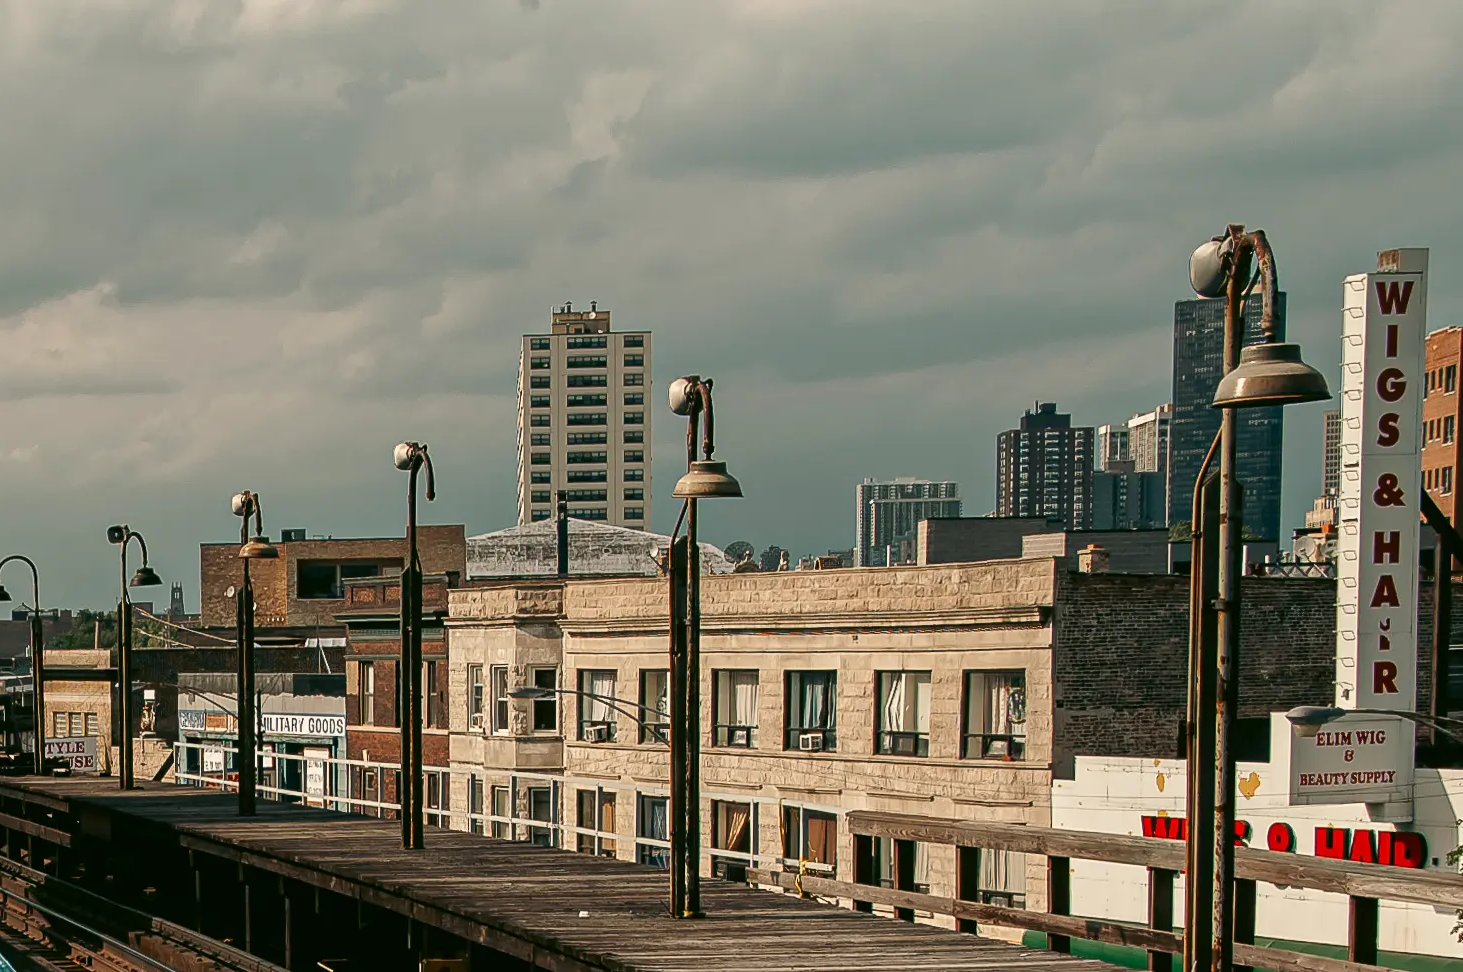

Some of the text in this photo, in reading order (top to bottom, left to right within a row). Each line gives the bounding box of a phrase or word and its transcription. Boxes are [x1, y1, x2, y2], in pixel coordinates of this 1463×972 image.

[1375, 280, 1415, 448] WIGS
[1372, 472, 1407, 508] &
[308, 717, 344, 734] GOODS
[1316, 729, 1386, 747] ELIM WIG
[45, 741, 85, 755] TYLE
[1299, 770, 1396, 786] BEAUTY SUPPLY
